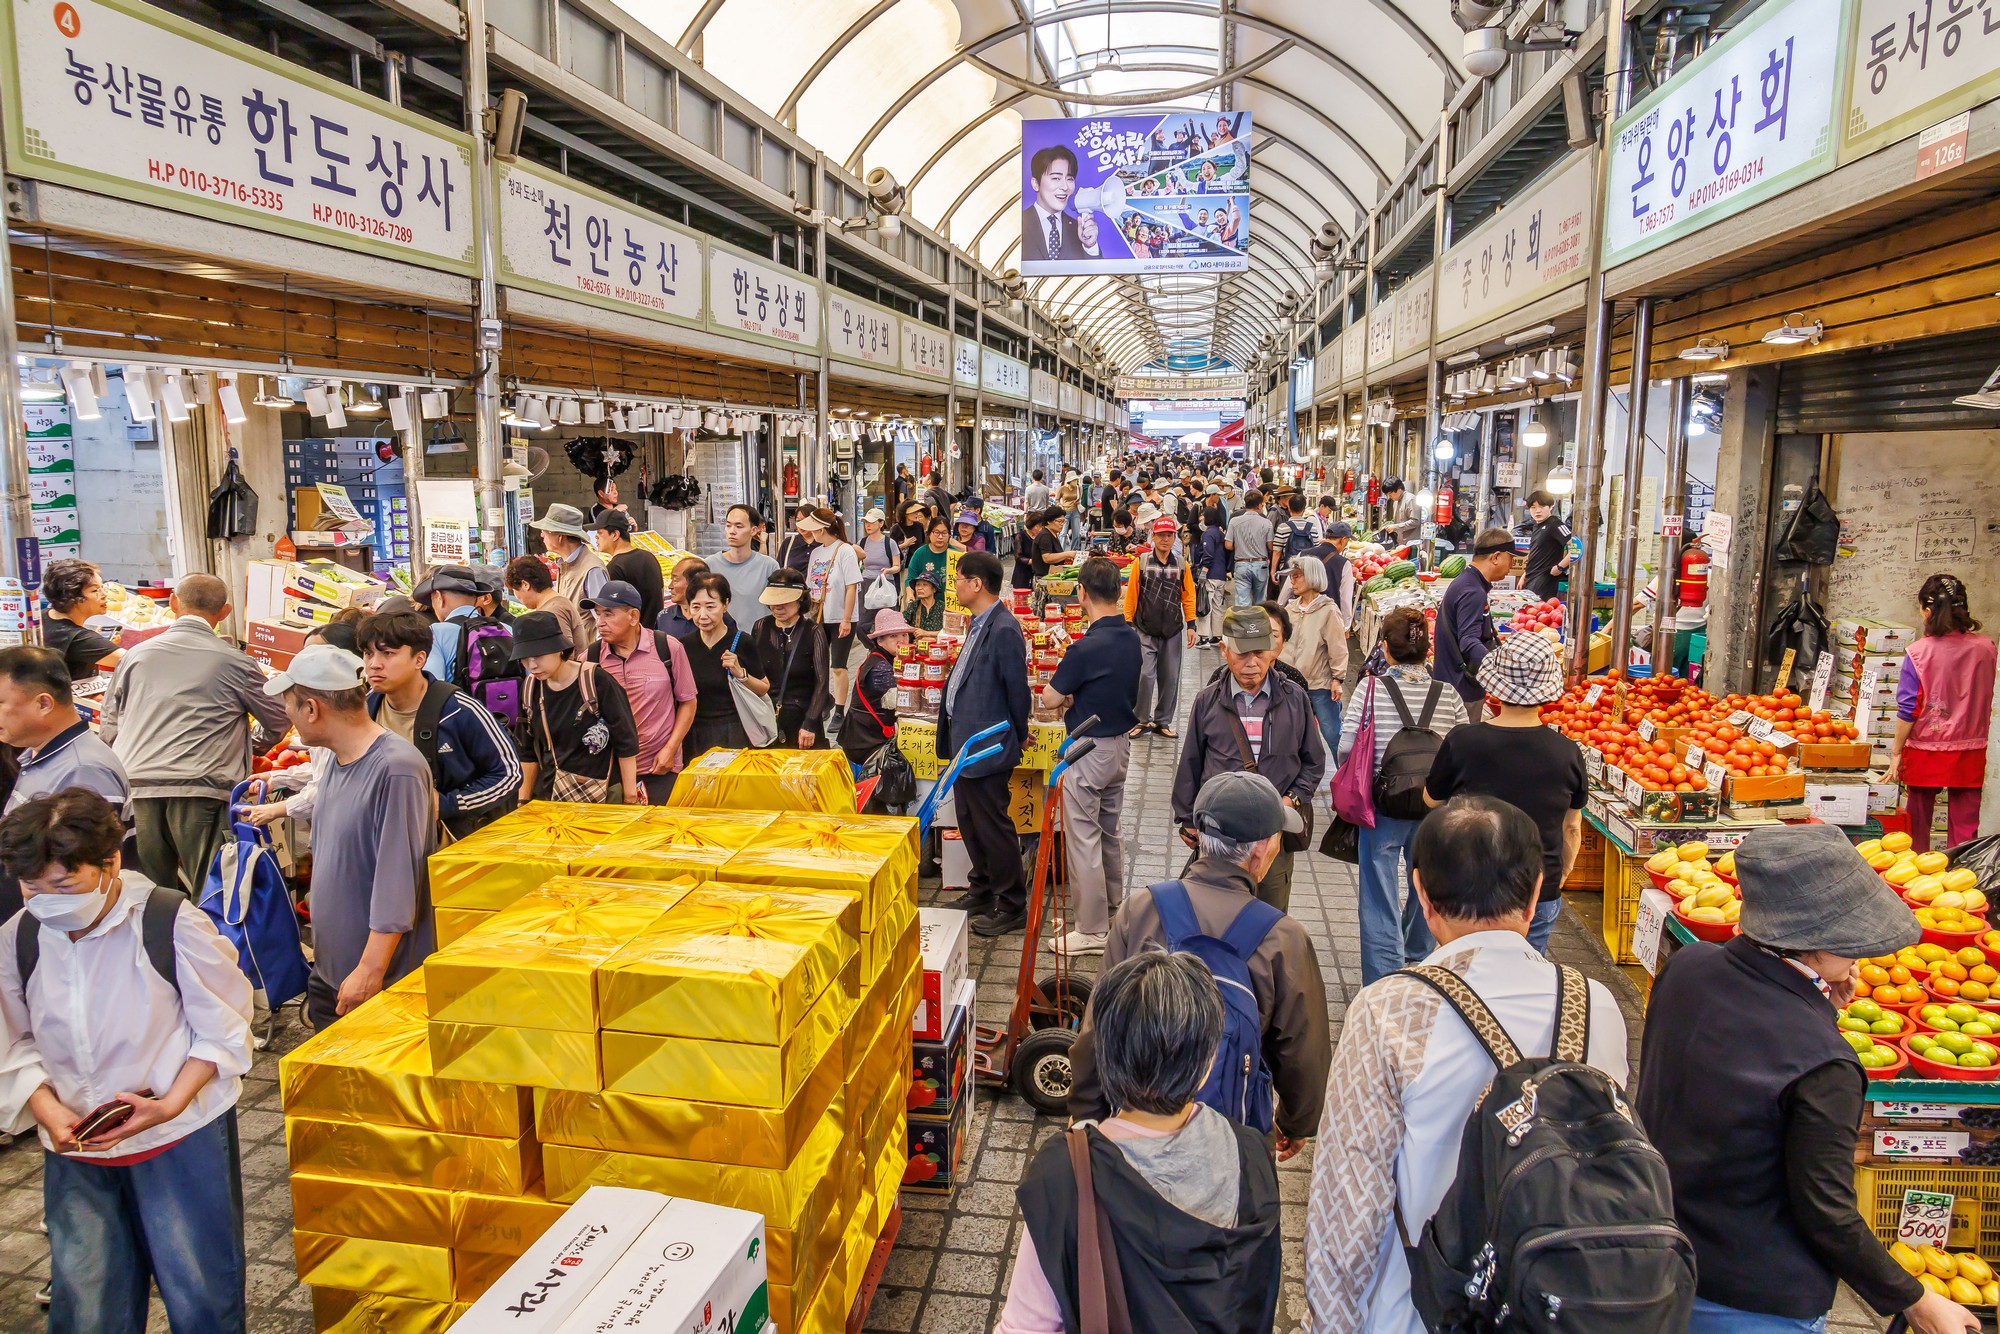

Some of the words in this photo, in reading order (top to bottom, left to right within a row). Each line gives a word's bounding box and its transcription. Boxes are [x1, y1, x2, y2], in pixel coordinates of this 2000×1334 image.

[59, 8, 74, 33] 4
[65, 48, 227, 146] 농산물유통
[242, 88, 454, 232] 한도상사
[1631, 36, 1795, 219] 온양상회
[1935, 142, 1962, 167] 126호
[178, 167, 283, 212] 010-3716-5335
[335, 210, 413, 243] 010-3126-7289
[545, 198, 678, 296] 천안농산
[1462, 208, 1542, 309] 중앙상회
[733, 267, 806, 332] 한농상회
[842, 309, 889, 356] 우성상회
[36, 418, 54, 427] 사과
[38, 454, 56, 462] 사과
[41, 490, 59, 499] 사과
[43, 525, 61, 533] 사과
[431, 532, 462, 543] 환급행사
[431, 543, 462, 554] 참여점포
[900, 740, 935, 754] 조개젓
[1900, 1220, 1946, 1239] 5000
[504, 1268, 567, 1318] 사과
